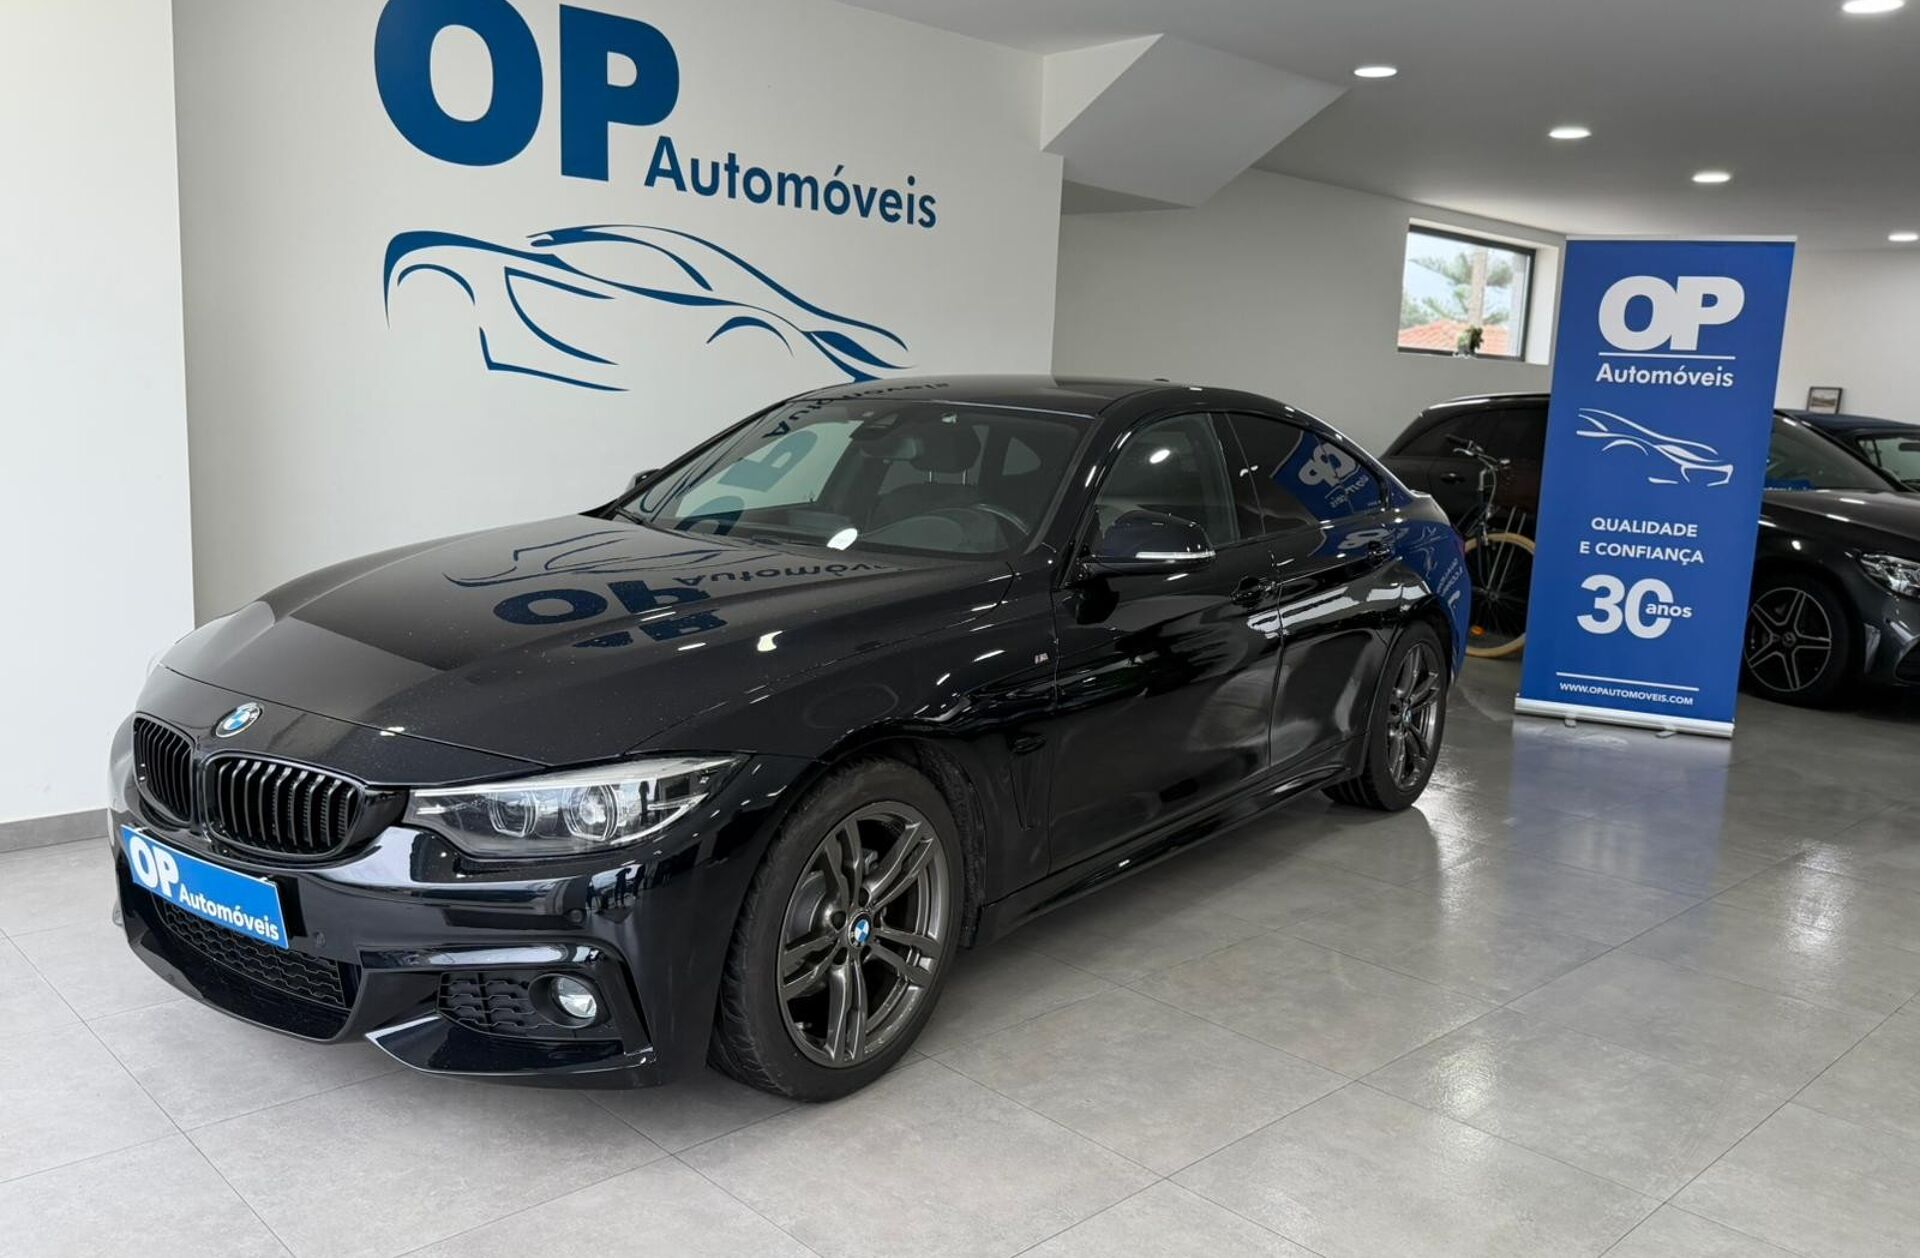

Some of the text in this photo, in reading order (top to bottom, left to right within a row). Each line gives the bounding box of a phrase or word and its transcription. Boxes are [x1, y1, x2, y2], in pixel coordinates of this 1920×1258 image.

[374, 0, 938, 229] OP Automóveis
[1598, 275, 1745, 351] OP
[1596, 363, 1734, 387] Automóveis
[1591, 517, 1698, 537] QUALIDADE
[1579, 541, 1704, 565] E CONFIANÇA
[1577, 574, 1692, 639] 30 anos
[1559, 682, 1693, 705] WWW.OPAUTOMOVEIS.COM
[129, 836, 280, 941] OP Automóveis
